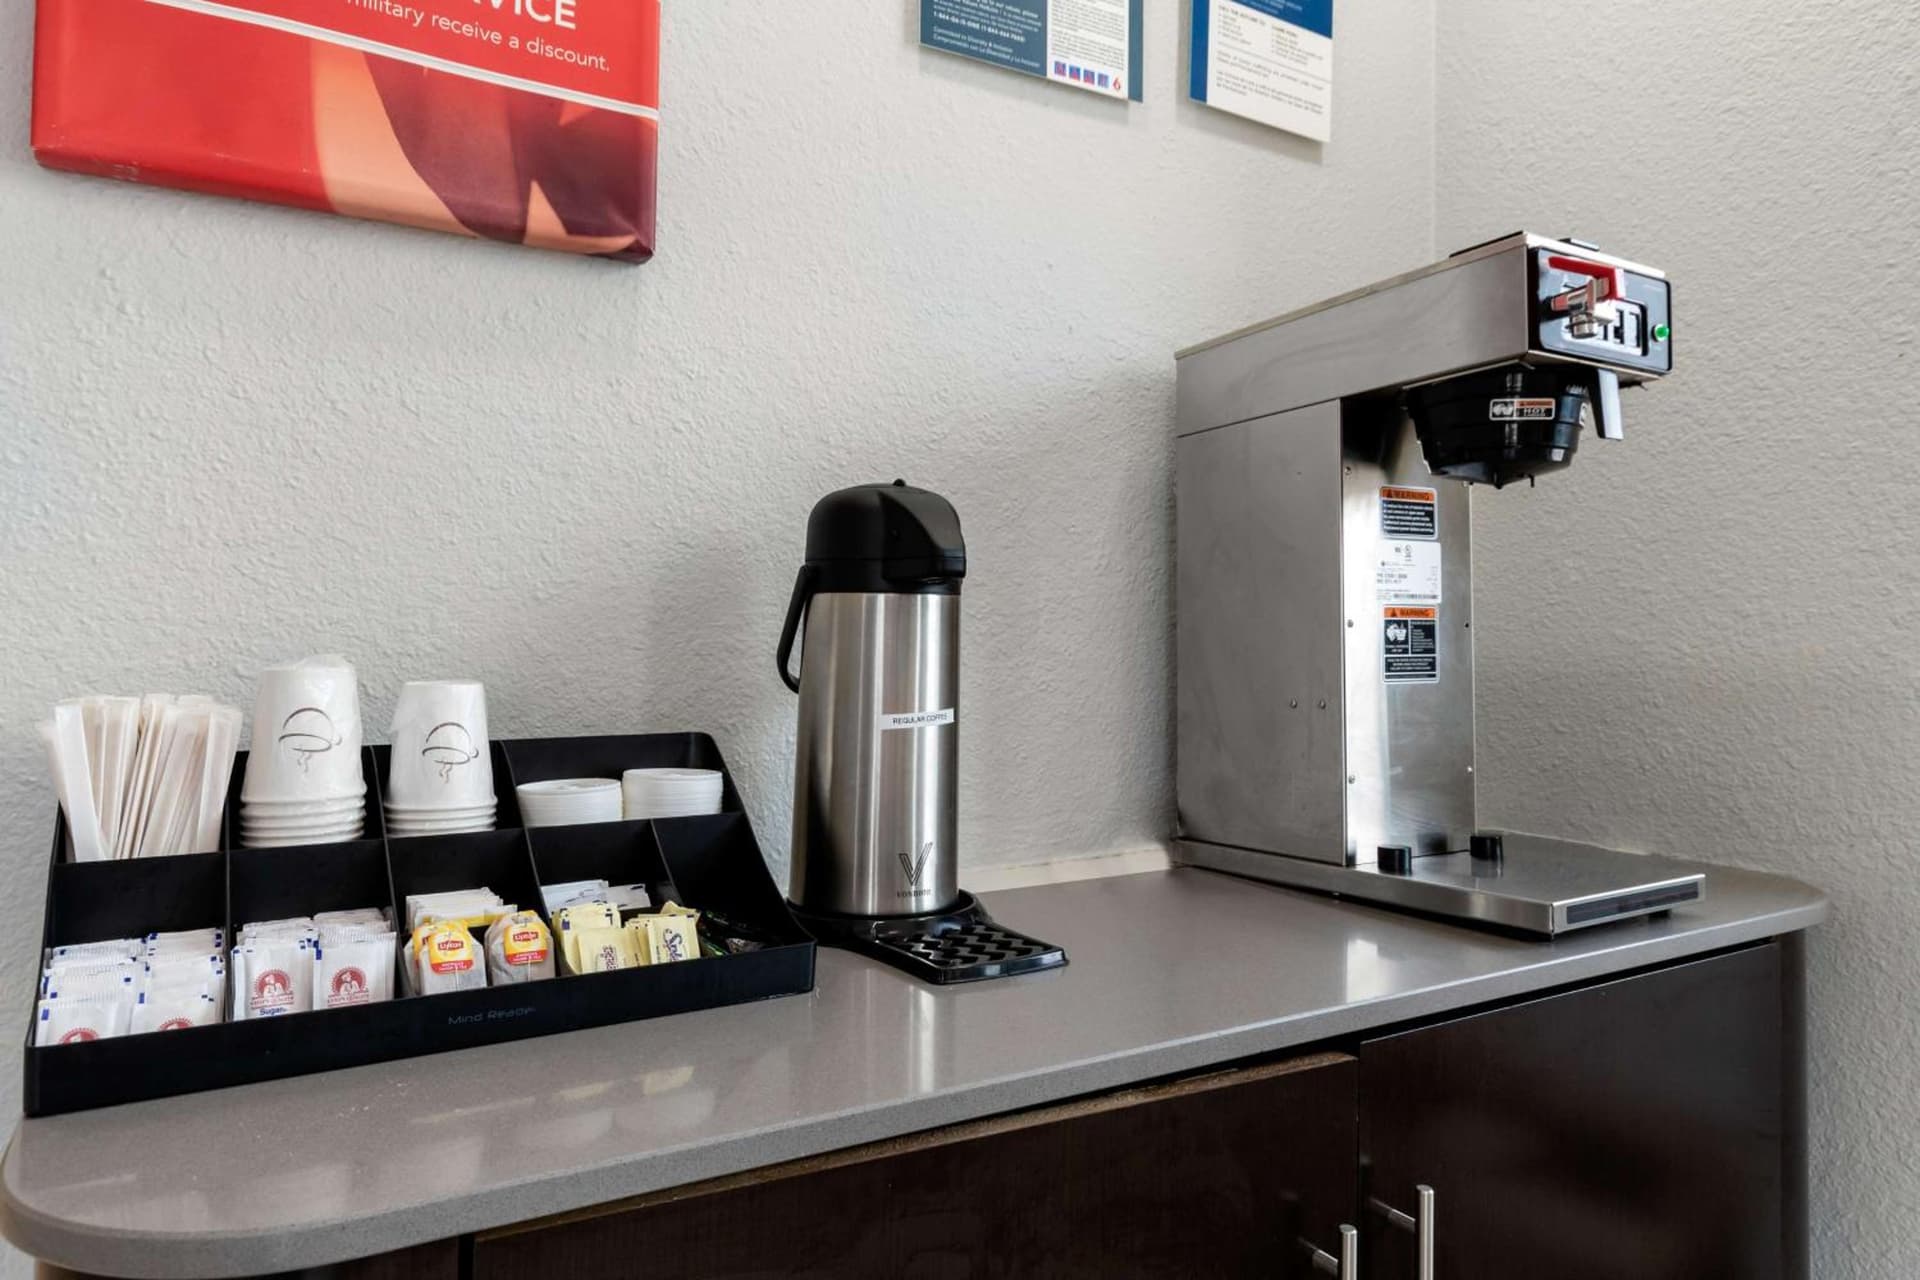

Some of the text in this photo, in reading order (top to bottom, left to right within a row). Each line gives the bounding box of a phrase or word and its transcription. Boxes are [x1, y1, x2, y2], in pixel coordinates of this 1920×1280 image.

[431, 14, 502, 45] receive
[508, 35, 520, 49] a
[526, 36, 610, 72] discount.
[448, 1011, 483, 1024] Mind
